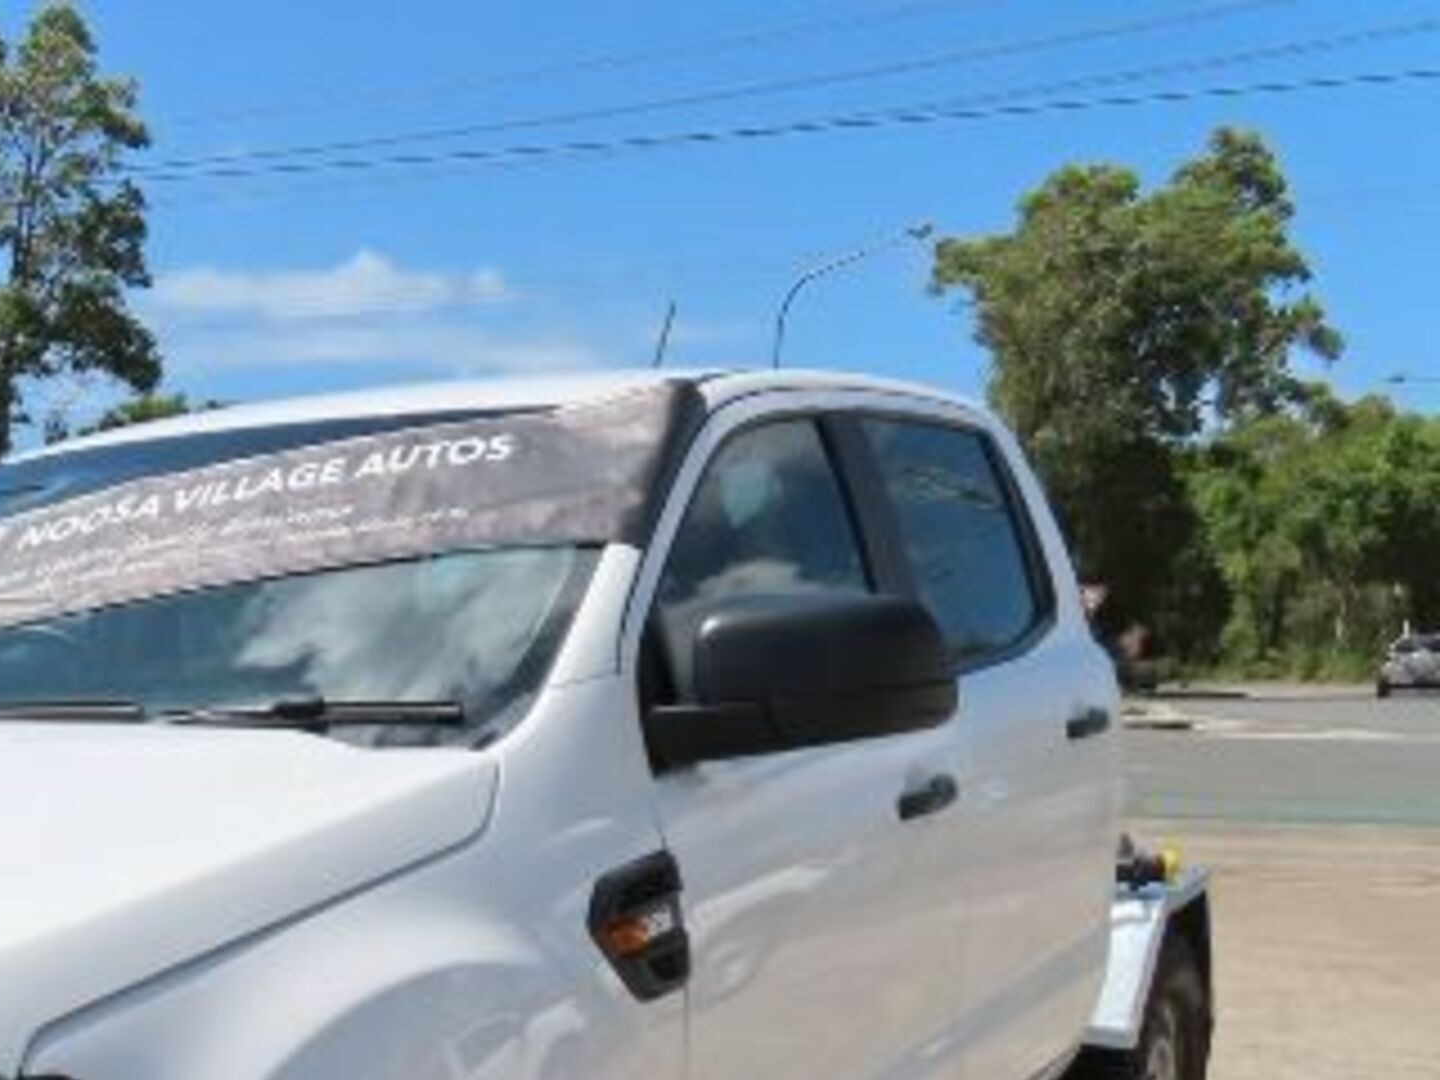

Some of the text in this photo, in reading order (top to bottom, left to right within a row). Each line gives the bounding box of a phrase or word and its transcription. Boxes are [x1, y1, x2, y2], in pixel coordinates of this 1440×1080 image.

[17, 494, 160, 551] NOOSA
[173, 457, 347, 512] VILLAGE
[355, 434, 515, 478] AUTOS
